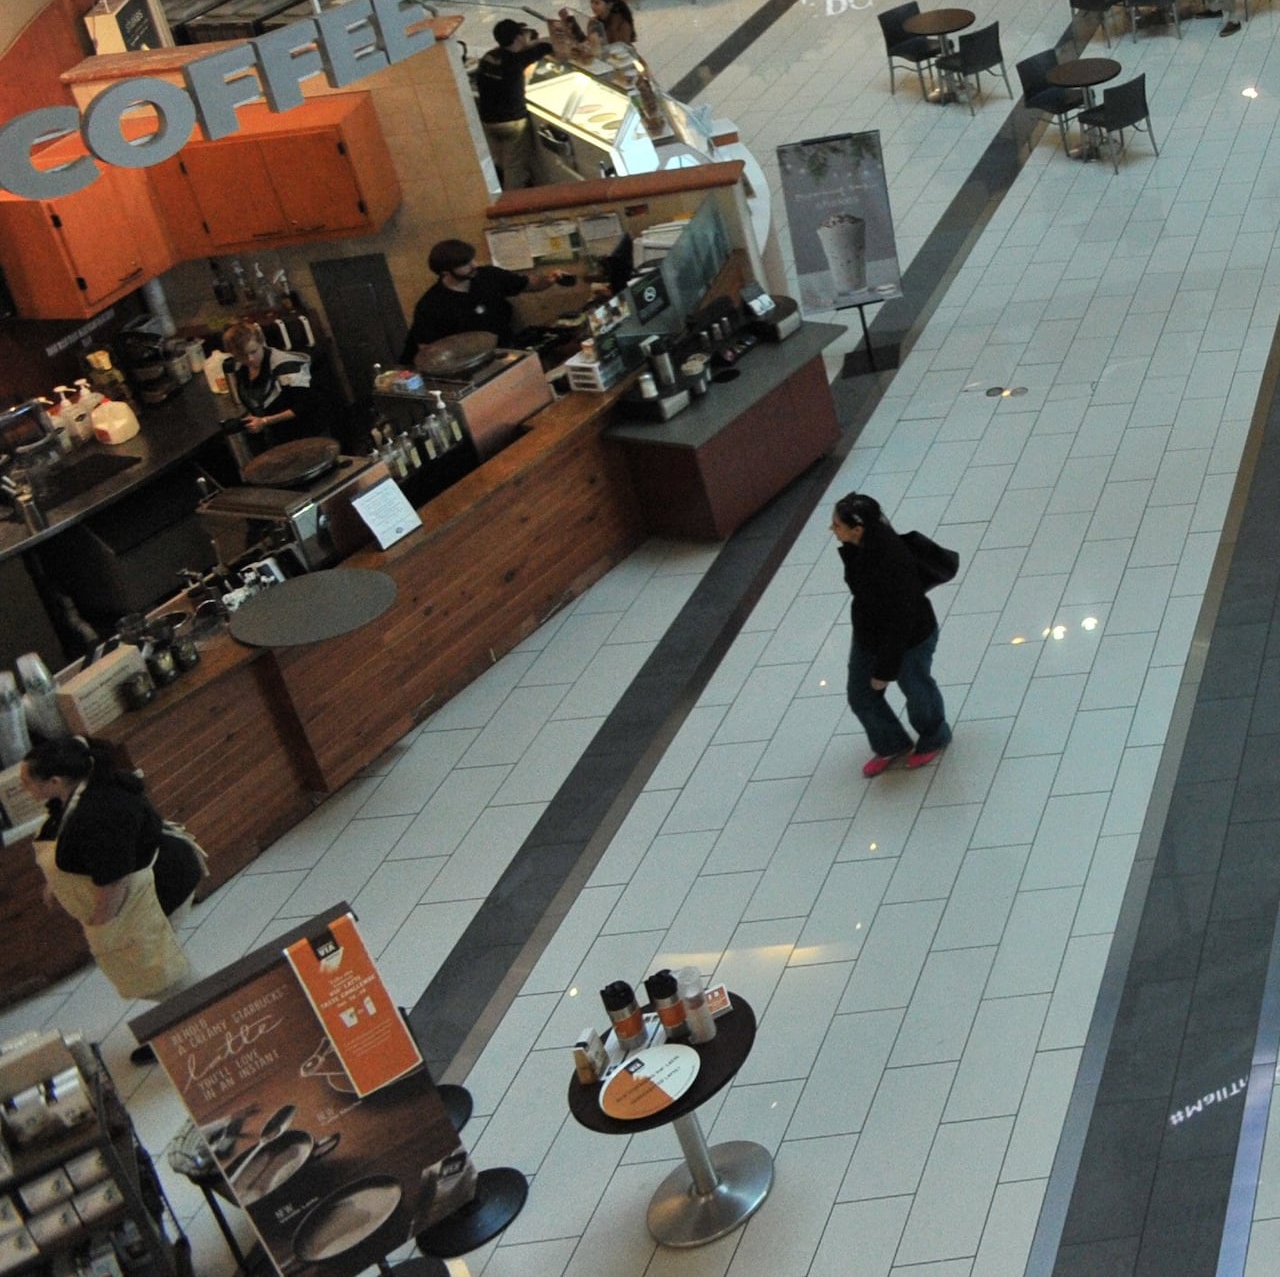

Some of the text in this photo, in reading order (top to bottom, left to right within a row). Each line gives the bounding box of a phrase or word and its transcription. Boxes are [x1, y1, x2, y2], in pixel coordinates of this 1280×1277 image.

[315, 940, 336, 957] VIA
[177, 1044, 187, 1057] A
[188, 1018, 228, 1048] CREAMY
[183, 1014, 285, 1095] latte
[203, 1048, 280, 1101] IN AN INSTANT
[235, 1048, 259, 1069] LOVE
